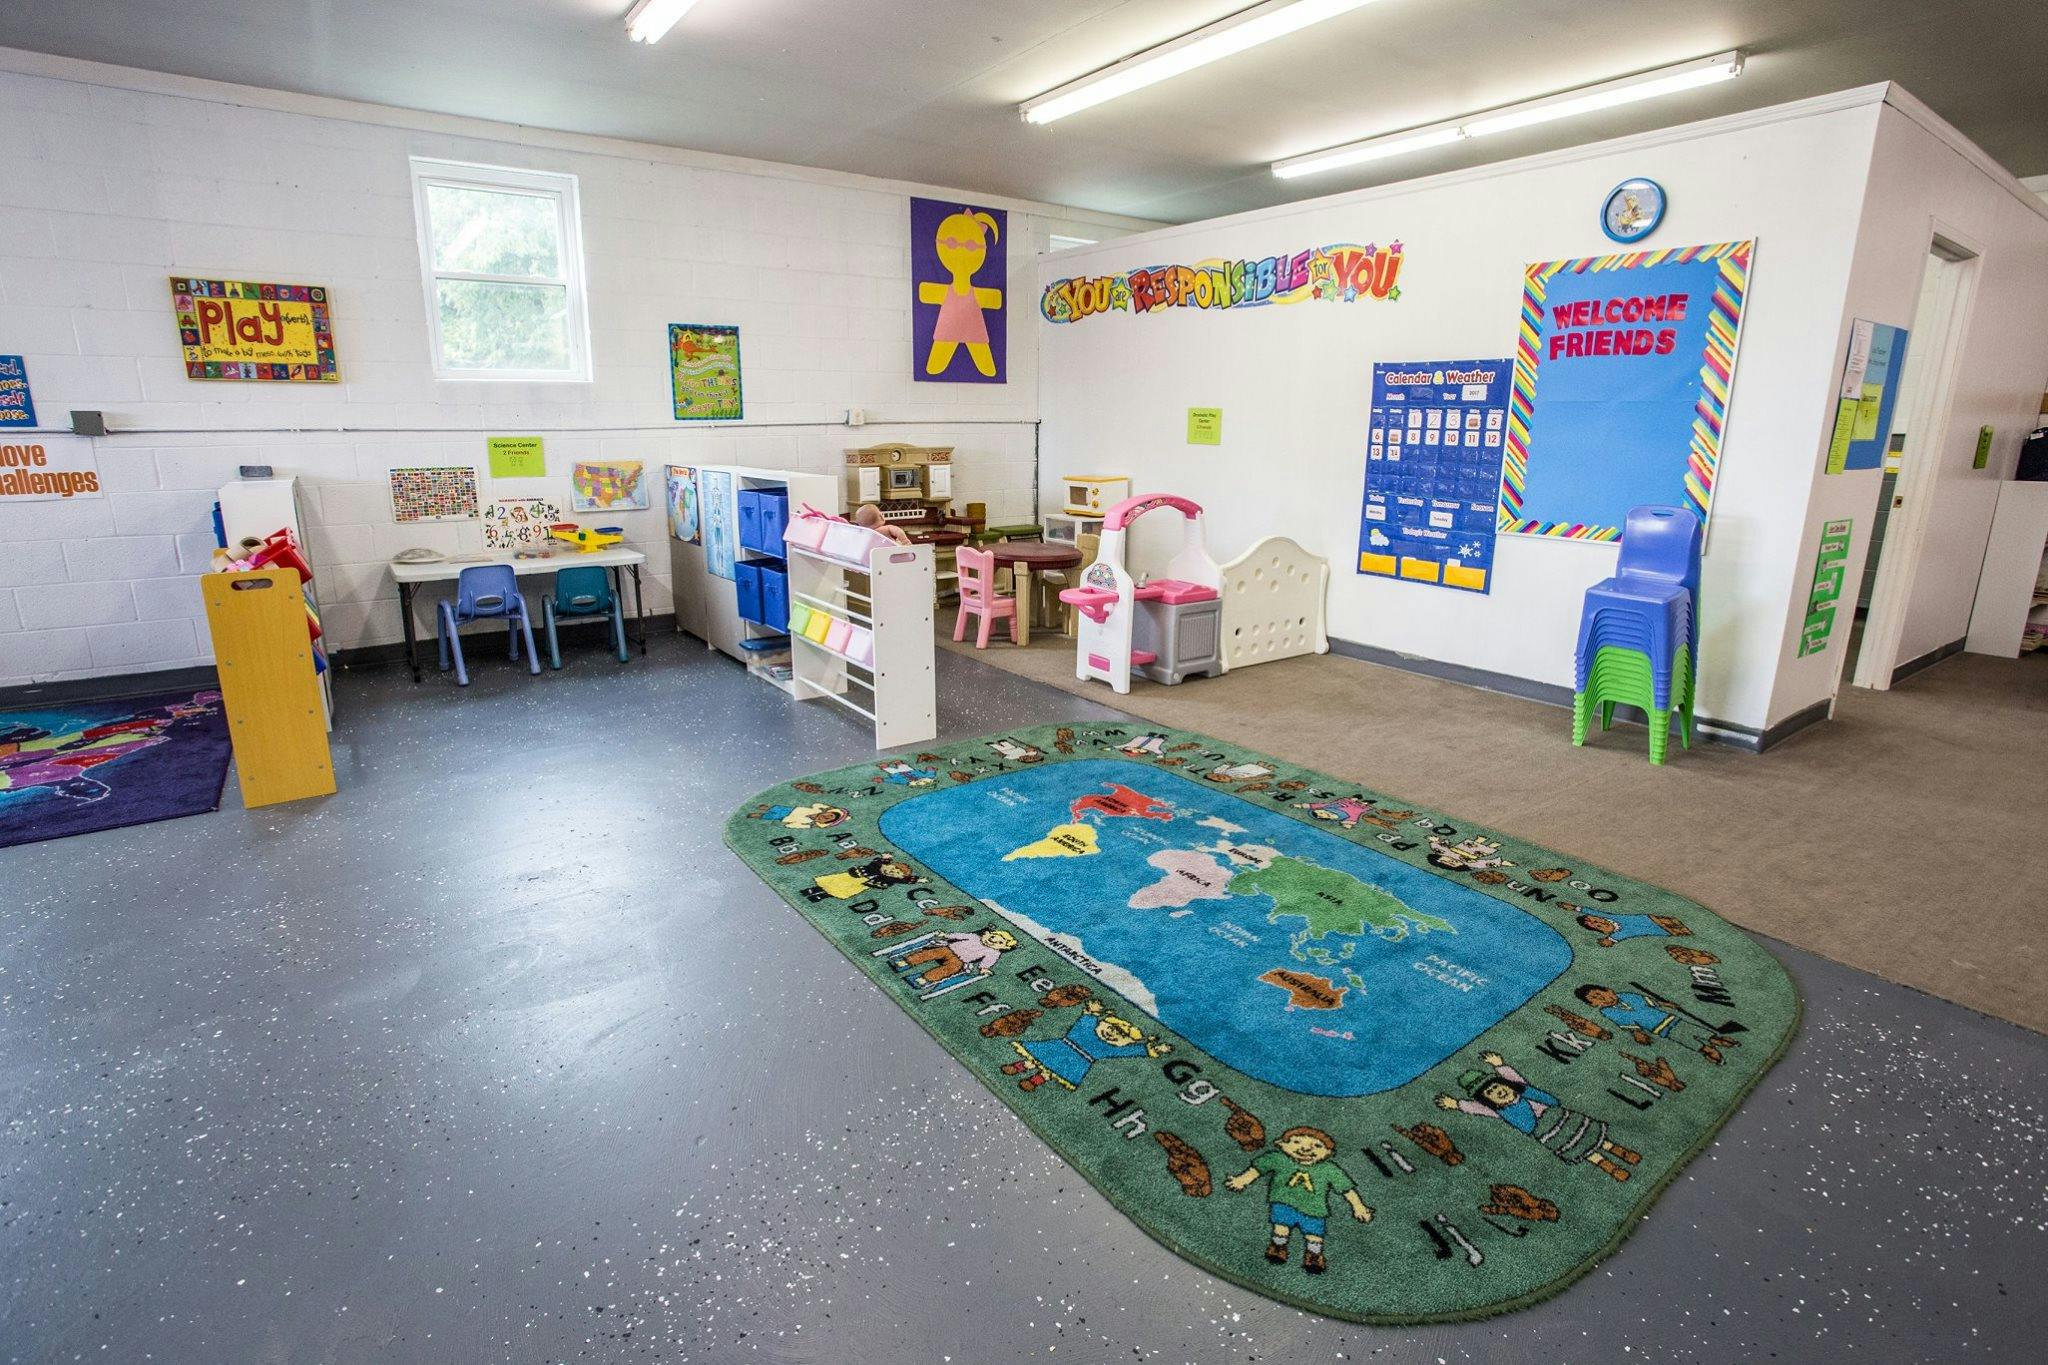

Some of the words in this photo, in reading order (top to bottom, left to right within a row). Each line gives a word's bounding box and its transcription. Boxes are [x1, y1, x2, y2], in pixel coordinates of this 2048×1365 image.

[1060, 275, 1115, 323] YOU
[1114, 288, 1128, 302] are
[1313, 259, 1330, 276] for
[1332, 249, 1403, 299] YOU
[1552, 293, 1689, 330] WELCOME
[197, 300, 284, 346] Play
[1549, 328, 1677, 361] FRIENDS
[1385, 372, 1433, 385] Calendar
[1447, 370, 1496, 384] Weather
[1429, 415, 1438, 425] 2
[1449, 415, 1458, 425] 3
[1490, 417, 1497, 426] 5
[1374, 432, 1380, 440] 6
[1410, 433, 1416, 441] 8
[1429, 433, 1435, 441] 9
[1447, 433, 1456, 442] 10
[1468, 434, 1476, 443] 11
[1488, 434, 1497, 443] 12
[1372, 448, 1380, 456] 13
[497, 506, 506, 520] 2
[489, 524, 498, 538] 6
[519, 526, 528, 541] 8
[533, 524, 542, 538] 9
[1175, 869, 1213, 888] AFRICA
[1316, 891, 1344, 906] ASIA
[1413, 962, 1473, 993] OCEAN
[1274, 969, 1336, 1007] AUSTRALIA
